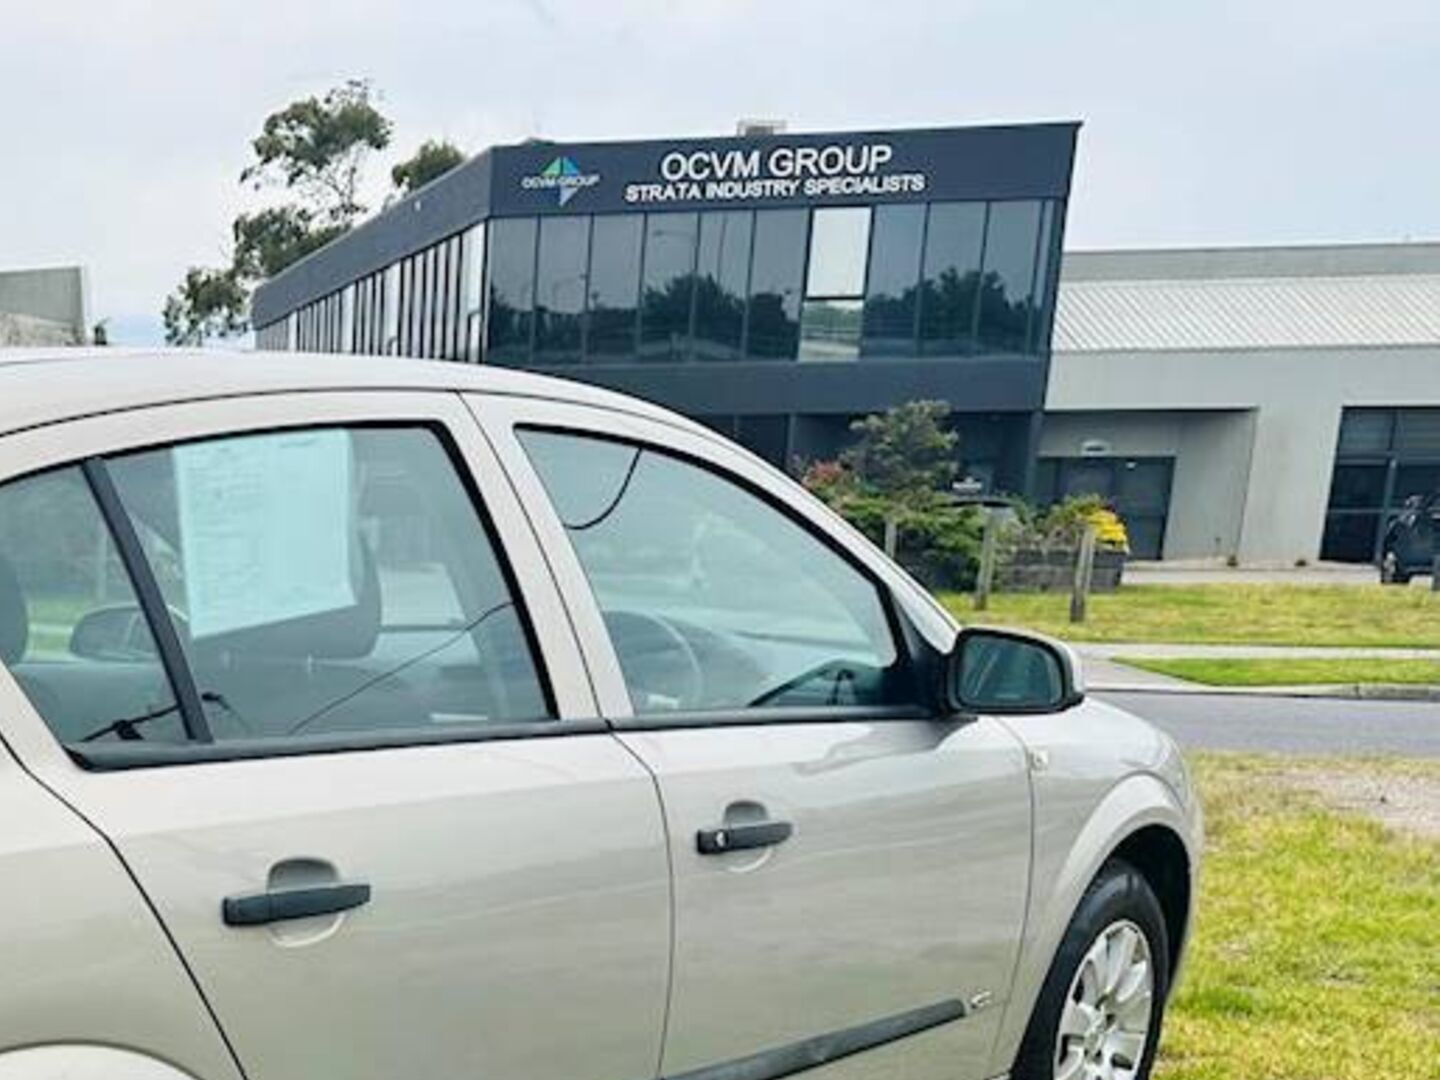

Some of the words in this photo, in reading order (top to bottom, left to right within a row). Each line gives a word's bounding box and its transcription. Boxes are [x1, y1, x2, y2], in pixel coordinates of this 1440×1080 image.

[661, 151, 760, 182] OCVM
[768, 144, 893, 177] GROUP
[624, 182, 703, 203] STRATA
[705, 178, 800, 200] INDUSTRY
[803, 173, 926, 196] SPECIALISTS
